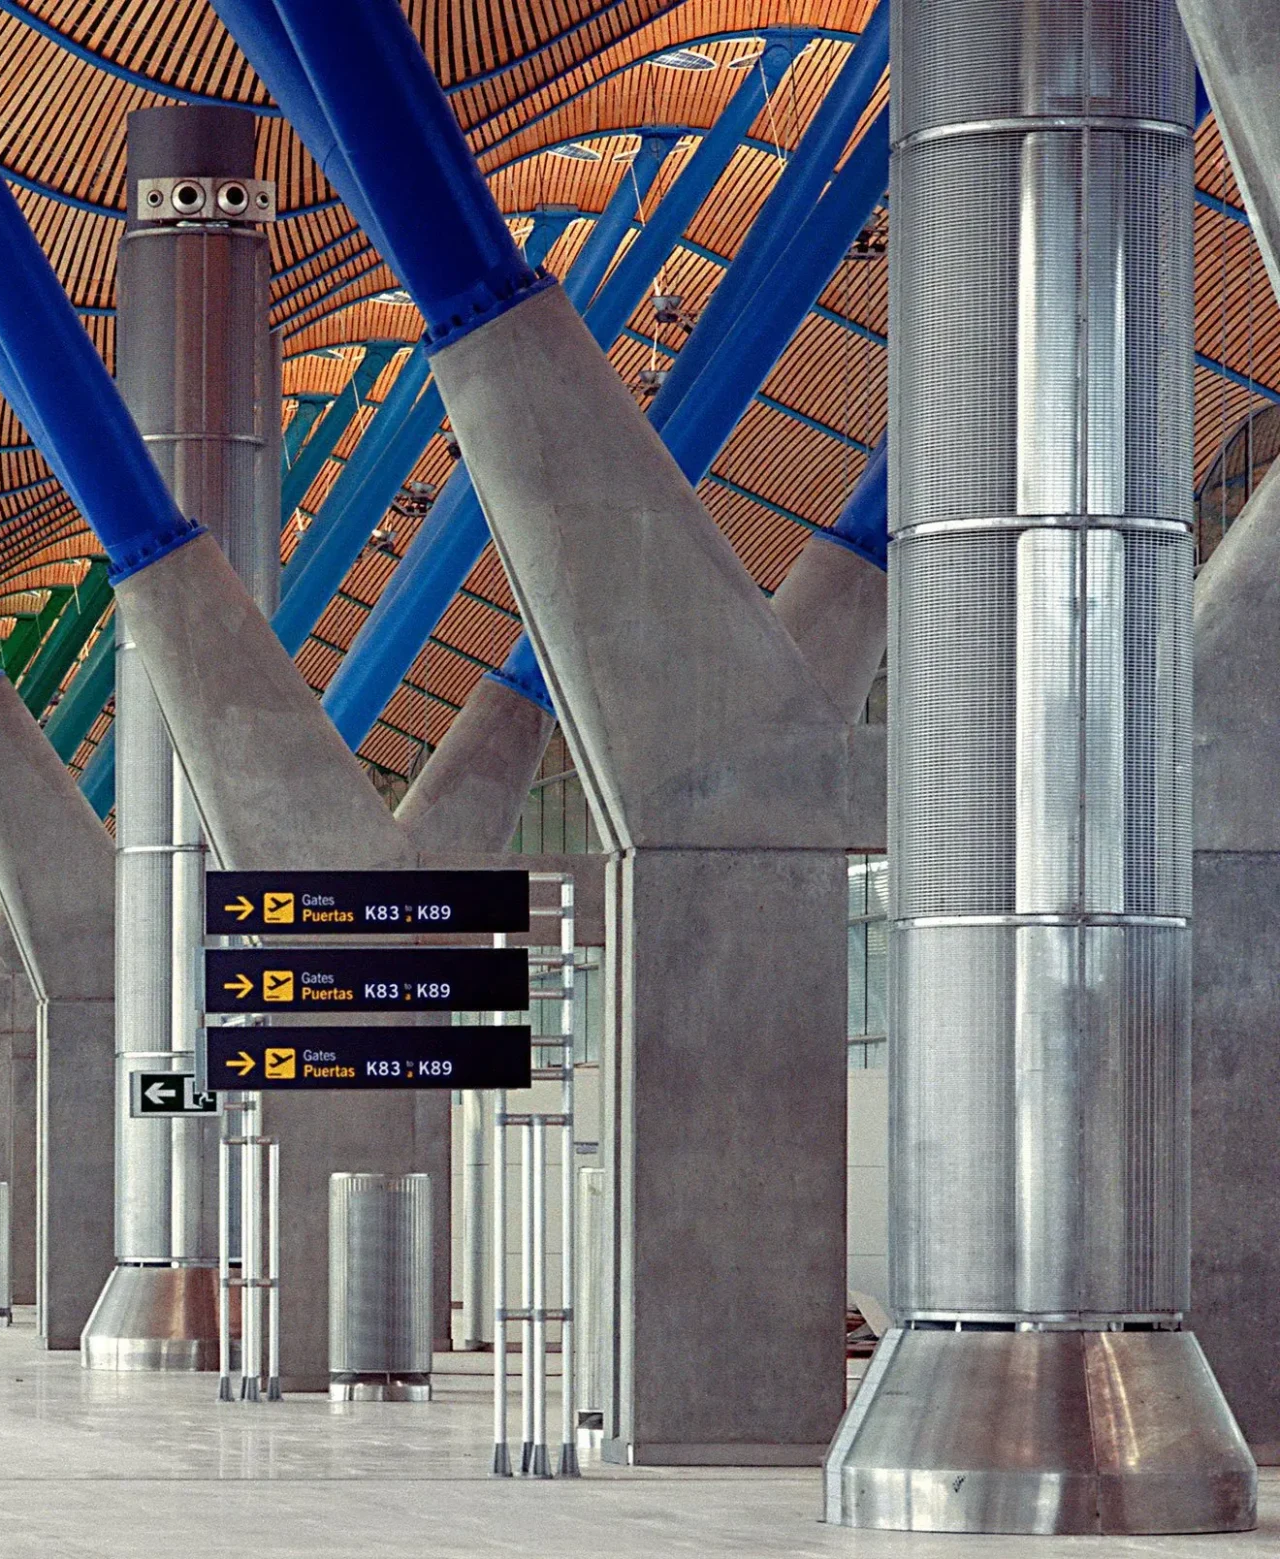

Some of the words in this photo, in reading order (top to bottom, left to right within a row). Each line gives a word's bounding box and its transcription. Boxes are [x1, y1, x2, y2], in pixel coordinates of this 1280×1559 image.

[302, 894, 335, 906] Gates
[302, 909, 354, 922] Puertas
[365, 905, 400, 920] K83
[405, 904, 412, 912] to
[417, 905, 451, 920] K89
[301, 972, 334, 984] Gates
[301, 987, 353, 1000] Puertas
[364, 983, 399, 998] K83
[404, 982, 411, 990] to
[416, 983, 450, 998] K89
[303, 1050, 336, 1062] Gates
[303, 1065, 355, 1078] Puertas
[366, 1061, 401, 1076] K83
[406, 1060, 413, 1068] to
[418, 1061, 452, 1076] K89
